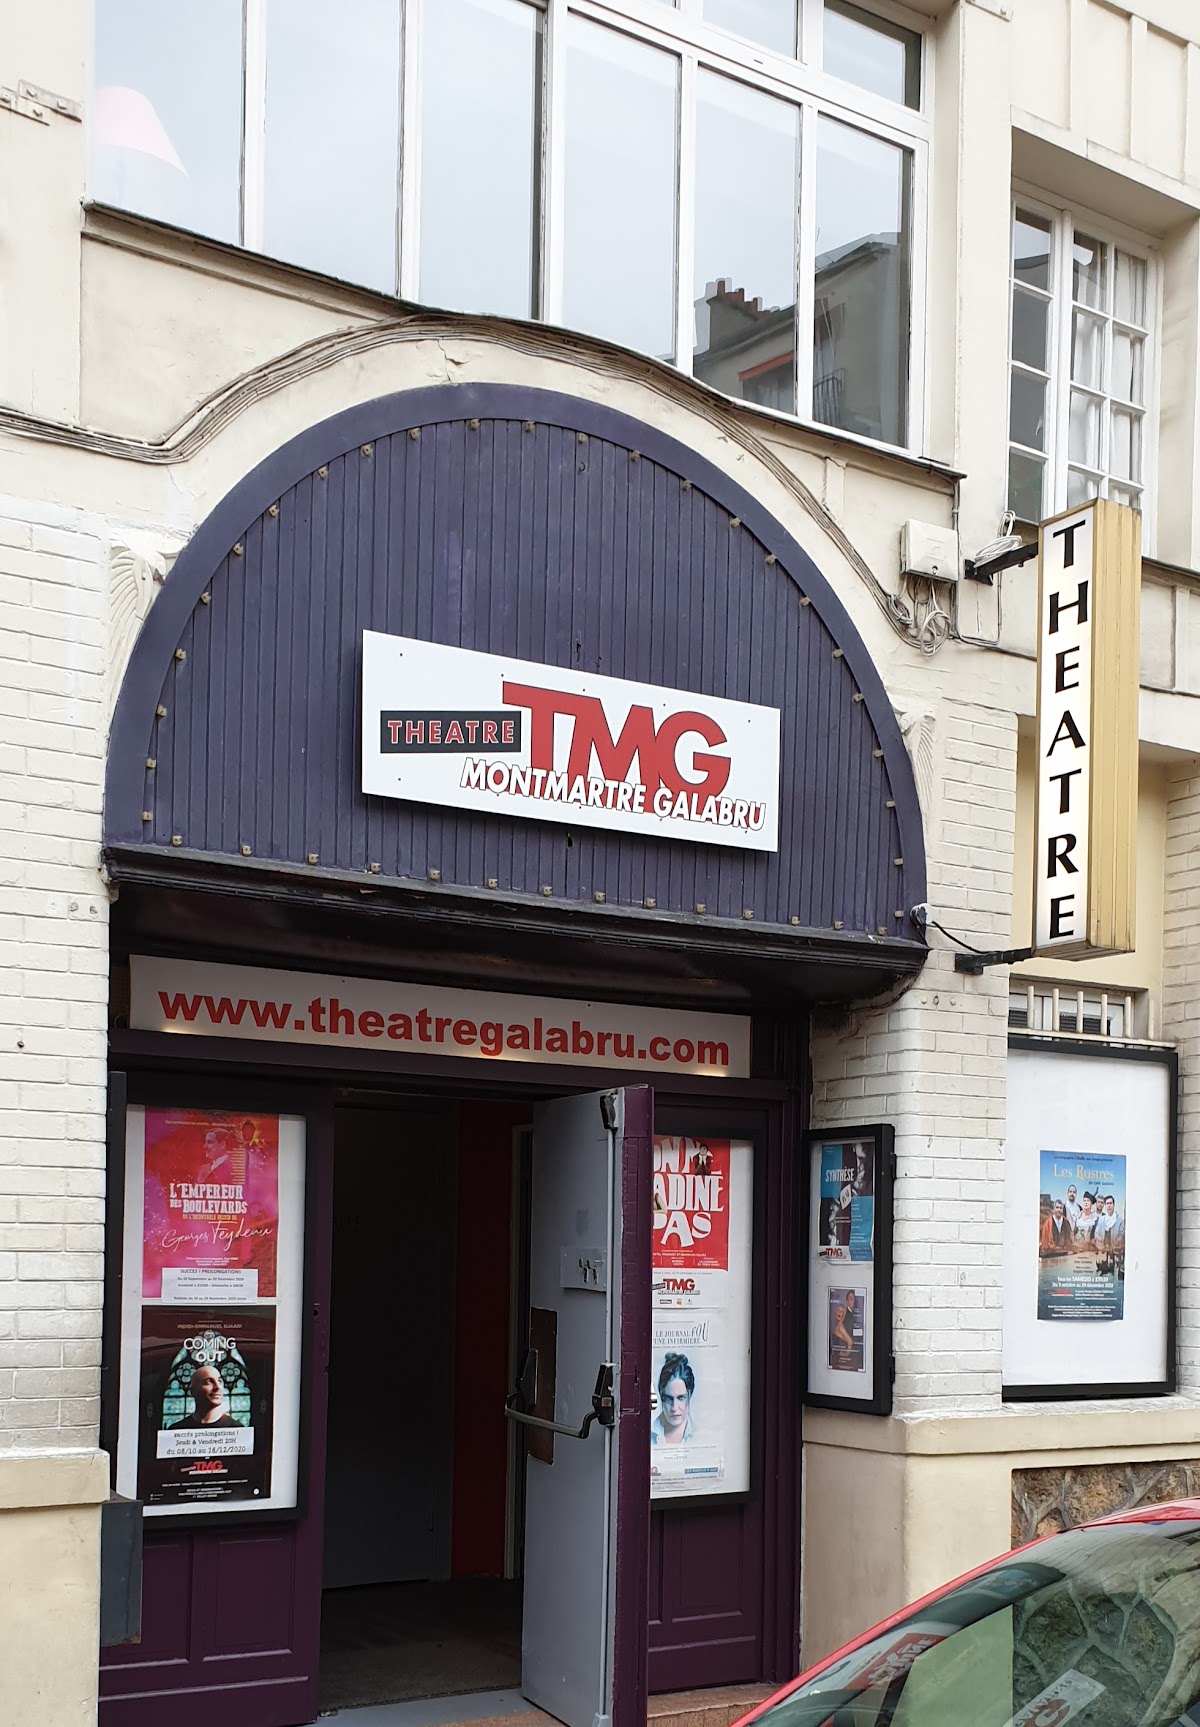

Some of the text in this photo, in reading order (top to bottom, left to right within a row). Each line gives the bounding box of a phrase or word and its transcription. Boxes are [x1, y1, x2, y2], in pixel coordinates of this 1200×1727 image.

[387, 719, 515, 745] THEATRE
[1046, 519, 1089, 940] THEATRE
[502, 681, 732, 798] TMG
[459, 757, 767, 831] MONTMARTRE GALABRU
[157, 991, 730, 1066] www.theatregalabru.com
[1053, 1164, 1114, 1181] Les Rustres
[170, 1183, 244, 1200] L'EMPEREUR
[170, 1198, 248, 1214] DES BOULEVARDS
[208, 1218, 274, 1252] Feydeau
[826, 1248, 842, 1257] TMG
[662, 1278, 695, 1291] TMG
[184, 1338, 236, 1350] COMING
[196, 1350, 224, 1362] OUT
[194, 1460, 223, 1472] TMG
